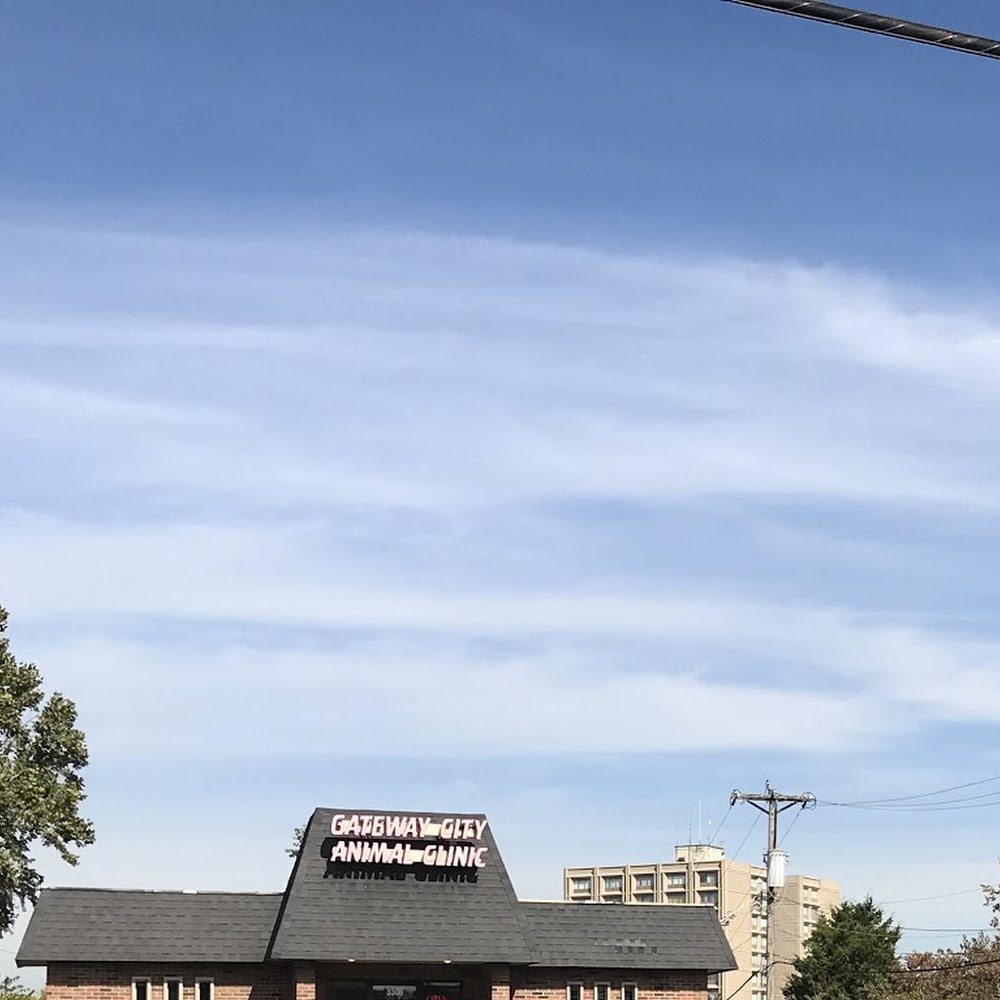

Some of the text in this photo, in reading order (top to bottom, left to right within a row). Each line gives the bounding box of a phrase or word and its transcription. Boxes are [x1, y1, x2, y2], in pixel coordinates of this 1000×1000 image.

[331, 813, 487, 840] GATEWAY CITY
[330, 840, 488, 868] ANIMAL CLINIC
